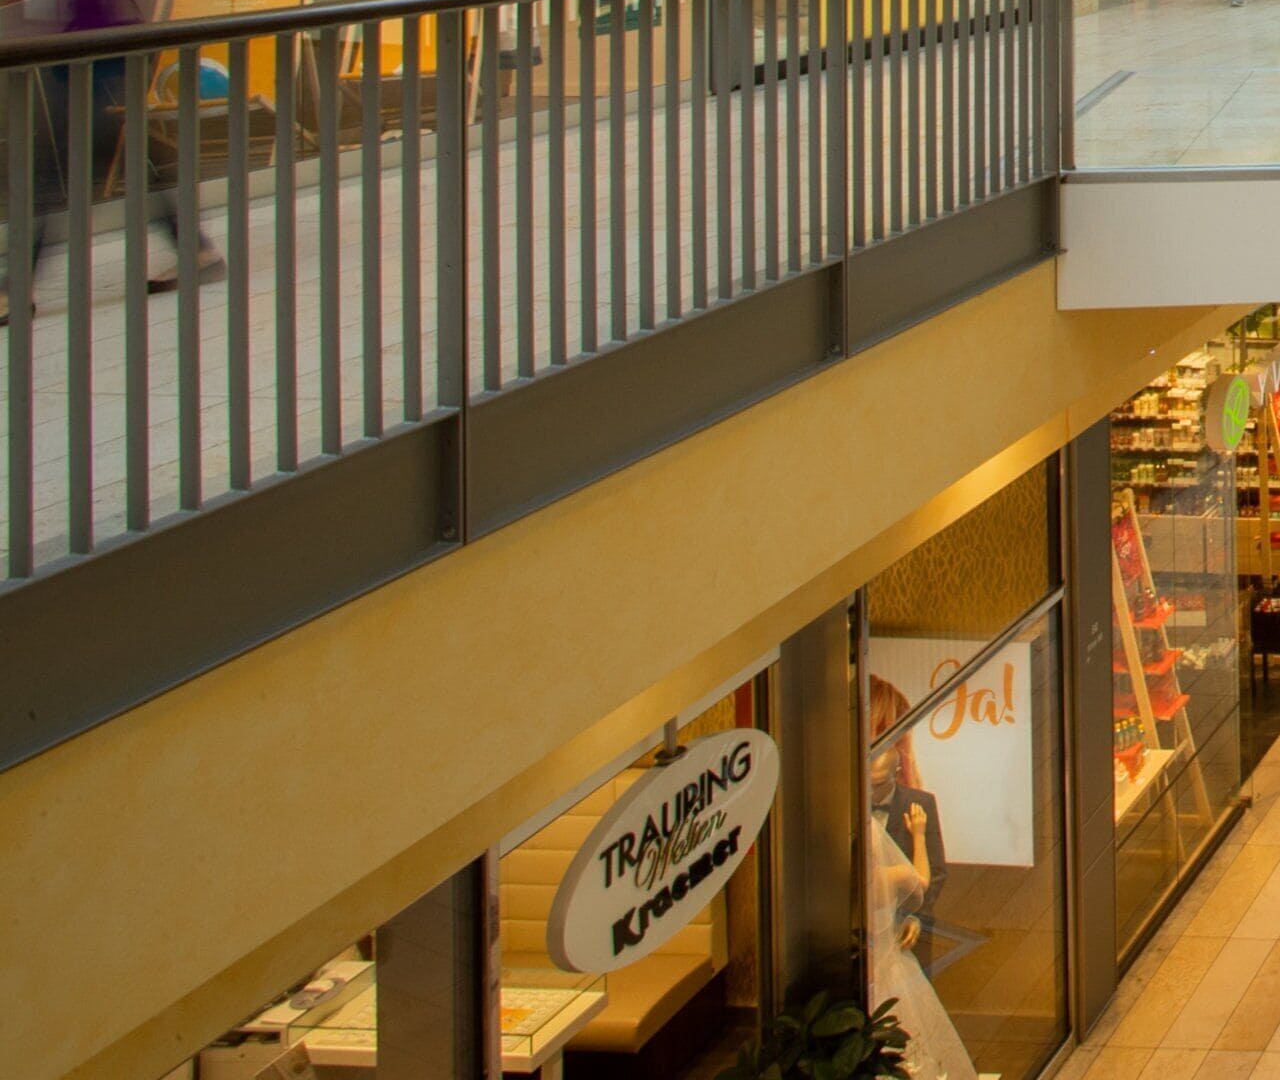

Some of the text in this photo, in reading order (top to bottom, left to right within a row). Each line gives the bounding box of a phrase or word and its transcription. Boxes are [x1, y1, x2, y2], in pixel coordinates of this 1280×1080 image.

[928, 658, 1016, 740] Ja!
[599, 740, 752, 889] TRAURING
[612, 825, 743, 957] Kraemer
